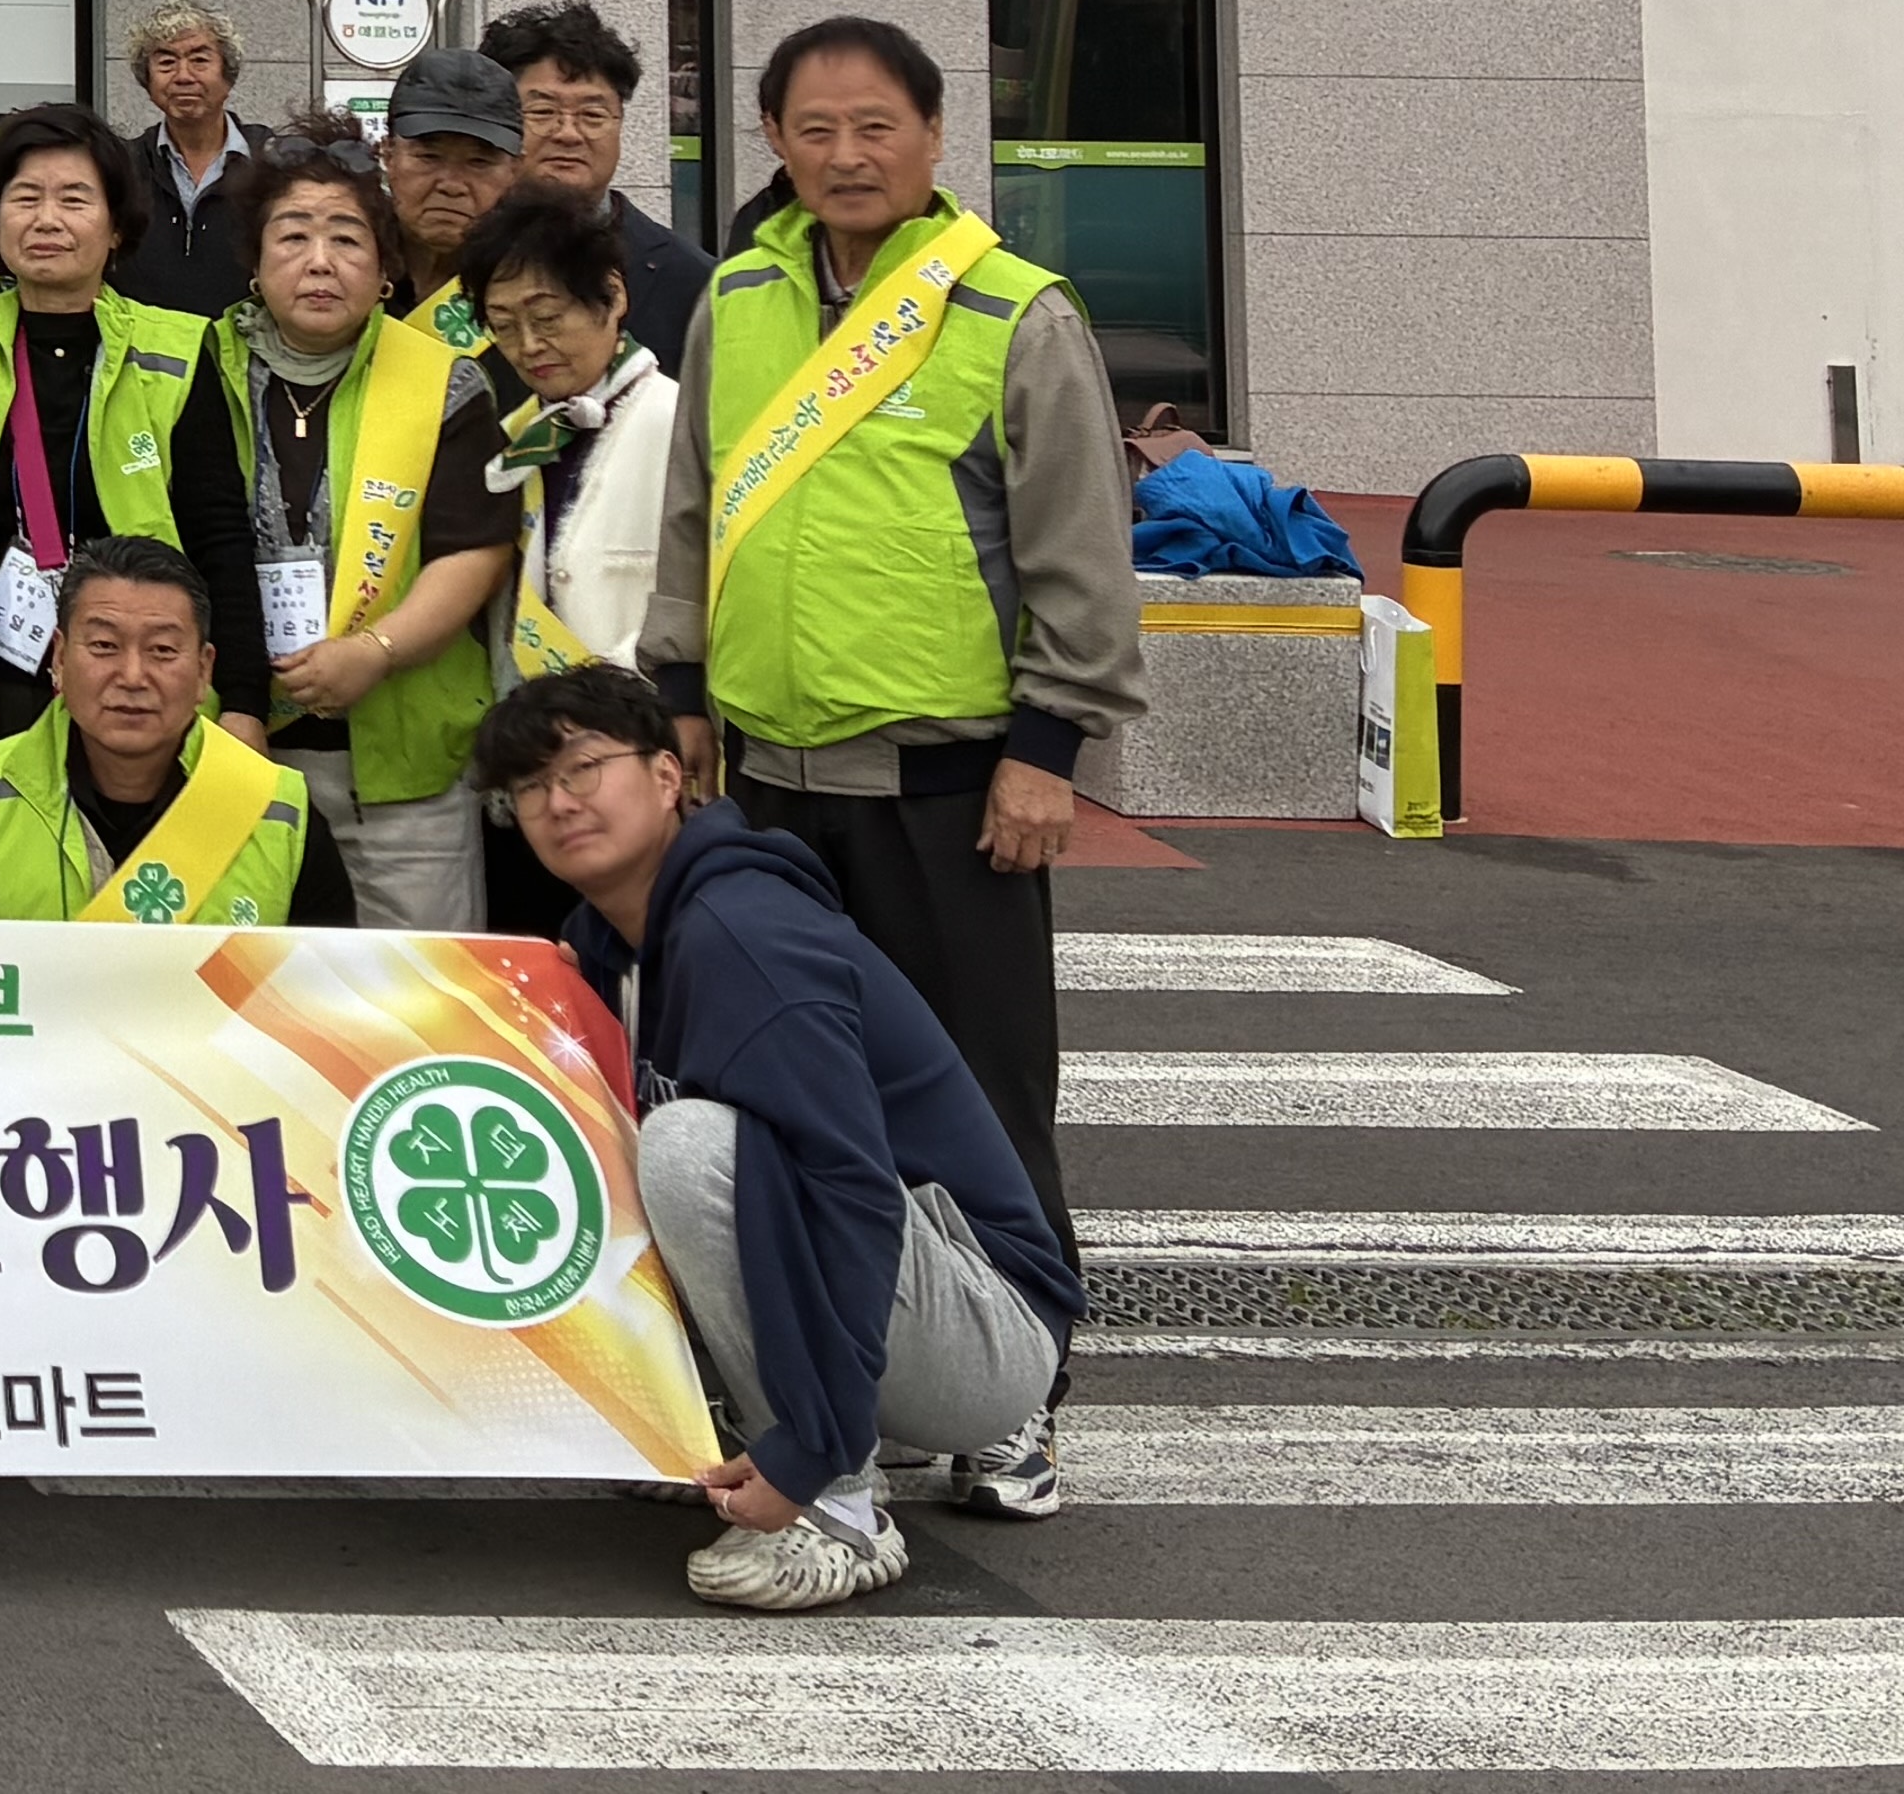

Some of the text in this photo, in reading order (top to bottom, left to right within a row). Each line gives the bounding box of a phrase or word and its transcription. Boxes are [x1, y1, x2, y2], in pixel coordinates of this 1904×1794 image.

[826, 297, 928, 399] 청원생명
[348, 1067, 451, 1264] HEAD HEART HANDS HEALTH
[405, 1123, 453, 1165] 지
[499, 1199, 543, 1243] 체
